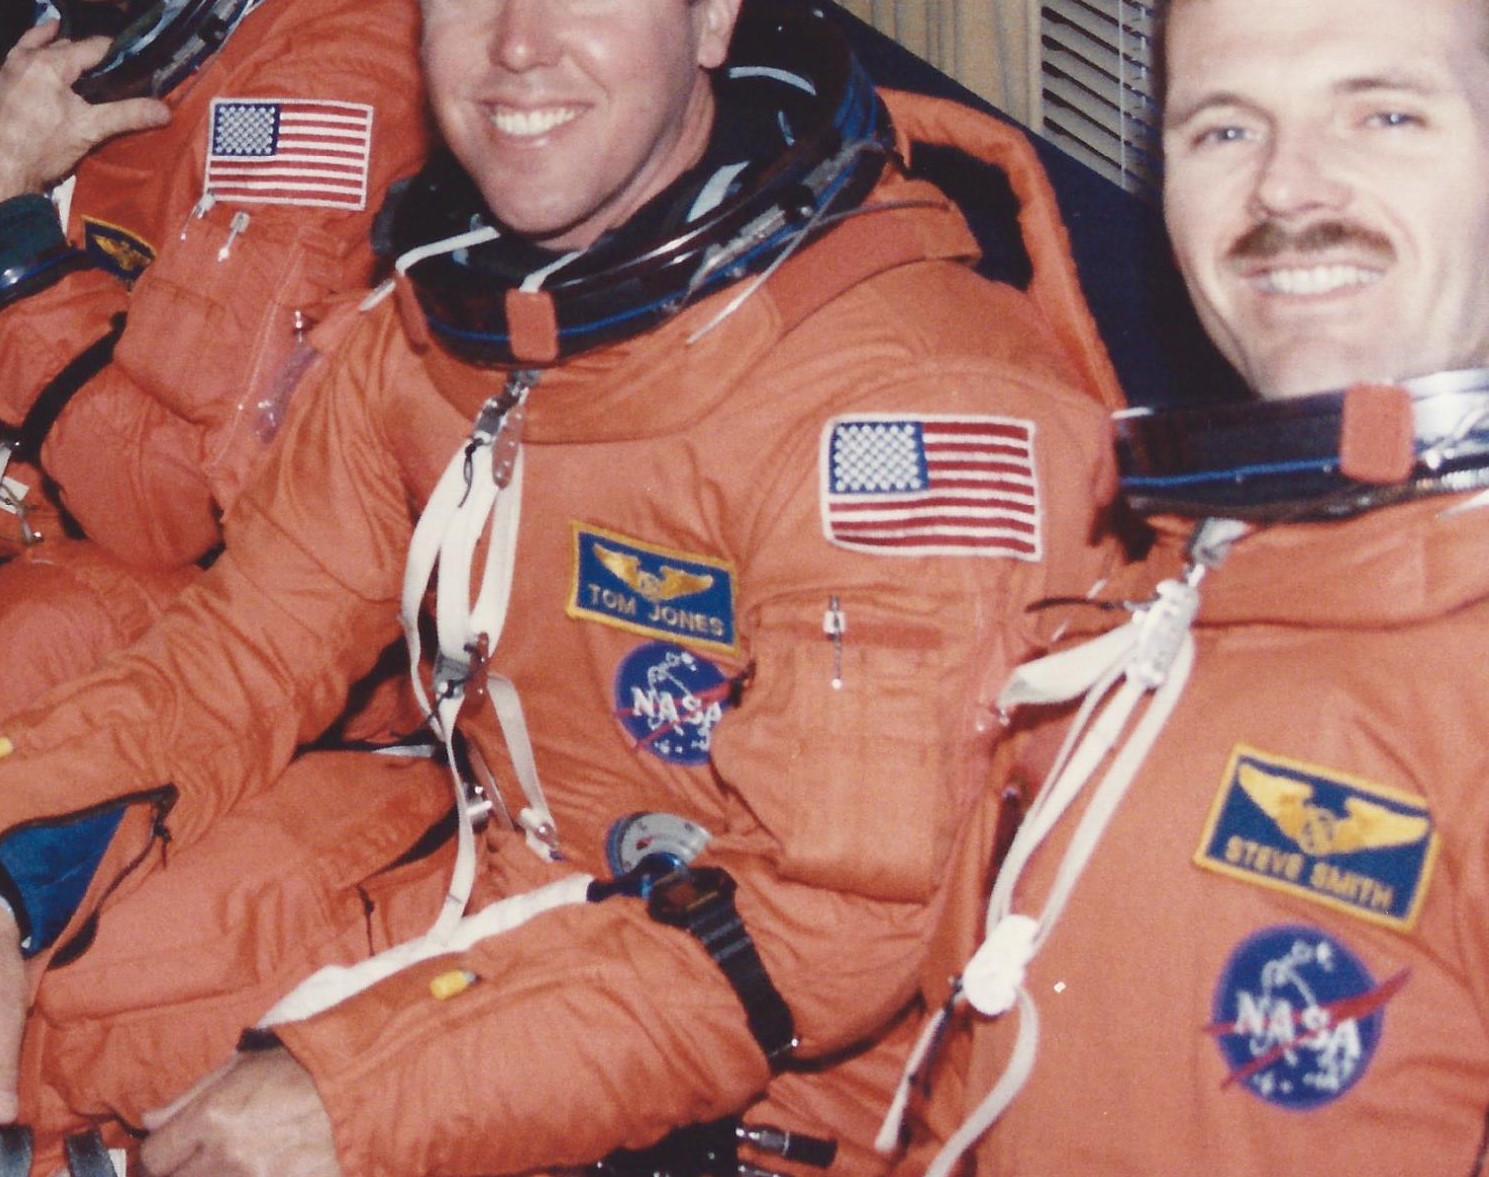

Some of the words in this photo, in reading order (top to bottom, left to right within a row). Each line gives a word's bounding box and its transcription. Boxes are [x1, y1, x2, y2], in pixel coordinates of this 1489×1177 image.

[588, 583, 636, 615] TOM
[648, 607, 725, 637] JONES
[631, 686, 722, 725] NASA
[1225, 835, 1304, 881] STEVE
[1310, 861, 1396, 909] SMITH
[1234, 990, 1360, 1060] NASA
